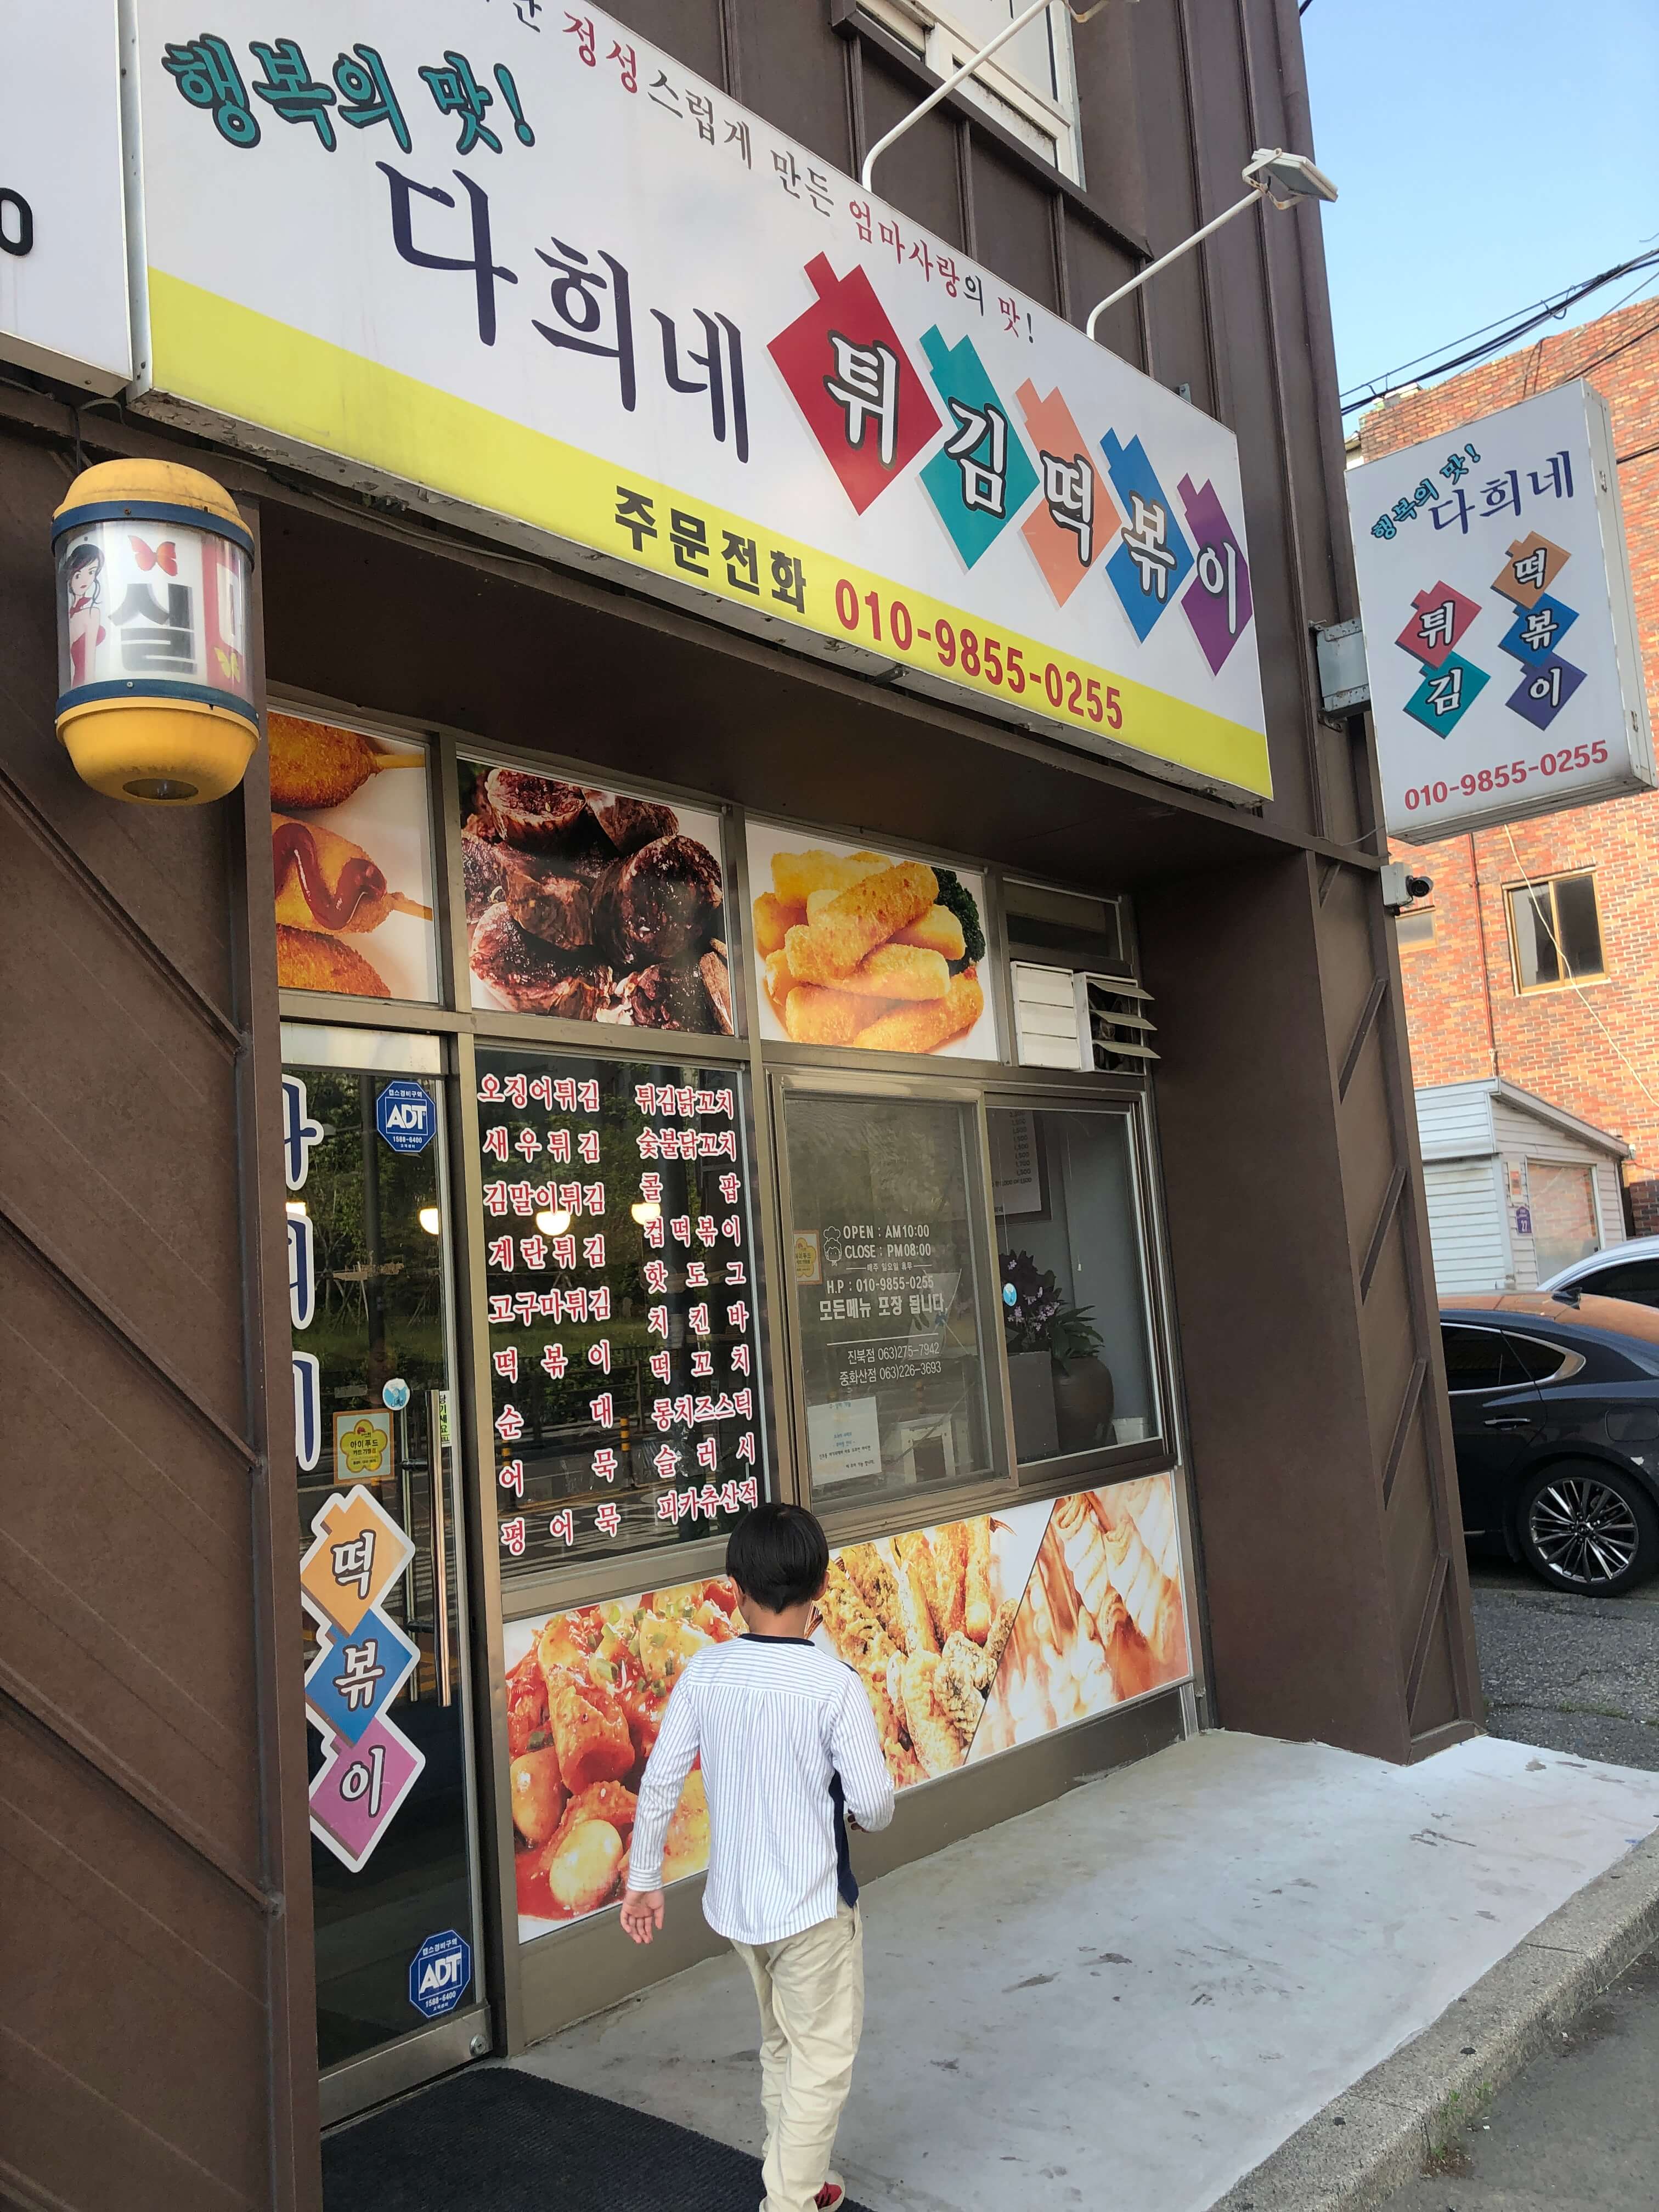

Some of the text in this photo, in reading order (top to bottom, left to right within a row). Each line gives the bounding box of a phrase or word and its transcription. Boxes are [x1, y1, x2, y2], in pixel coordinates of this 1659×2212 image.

[161, 33, 536, 154] 행복의 맛!
[562, 9, 1034, 343] 정성스럽게 만든 엄마사랑의 맛!
[375, 161, 749, 464] 다희네
[1370, 443, 1482, 540] 행복의 맛!
[1427, 450, 1574, 534] 다희네
[614, 485, 1124, 730] 주문전화 010-9855-0255
[108, 583, 198, 675] 실
[1404, 739, 1609, 810] 010-9855-0255
[478, 1073, 600, 1113] 오징어튀김
[634, 1082, 733, 1120] 튀김닭꼬치
[387, 1104, 426, 1129] ADT
[483, 1181, 605, 1216] 김말이튀김
[843, 1225, 874, 1239] OPEN
[845, 1244, 876, 1259] CLOSE
[856, 1276, 934, 1293] 010-9855-0255
[867, 1262, 912, 1272] 매주 일요일 휴무
[488, 1286, 610, 1326] 고구마튀김
[820, 1297, 871, 1321] 모든메뉴
[878, 1295, 902, 1316] 포장
[839, 1361, 941, 1386] 중화산점 063)226-3693
[848, 1342, 940, 1365] 진북점 063)275-7942
[651, 1387, 752, 1432] 롱치즈스틱
[350, 1439, 379, 1449] 아이푸드
[658, 1477, 758, 1525] 피카츄산적
[419, 1953, 461, 1994] ADT
